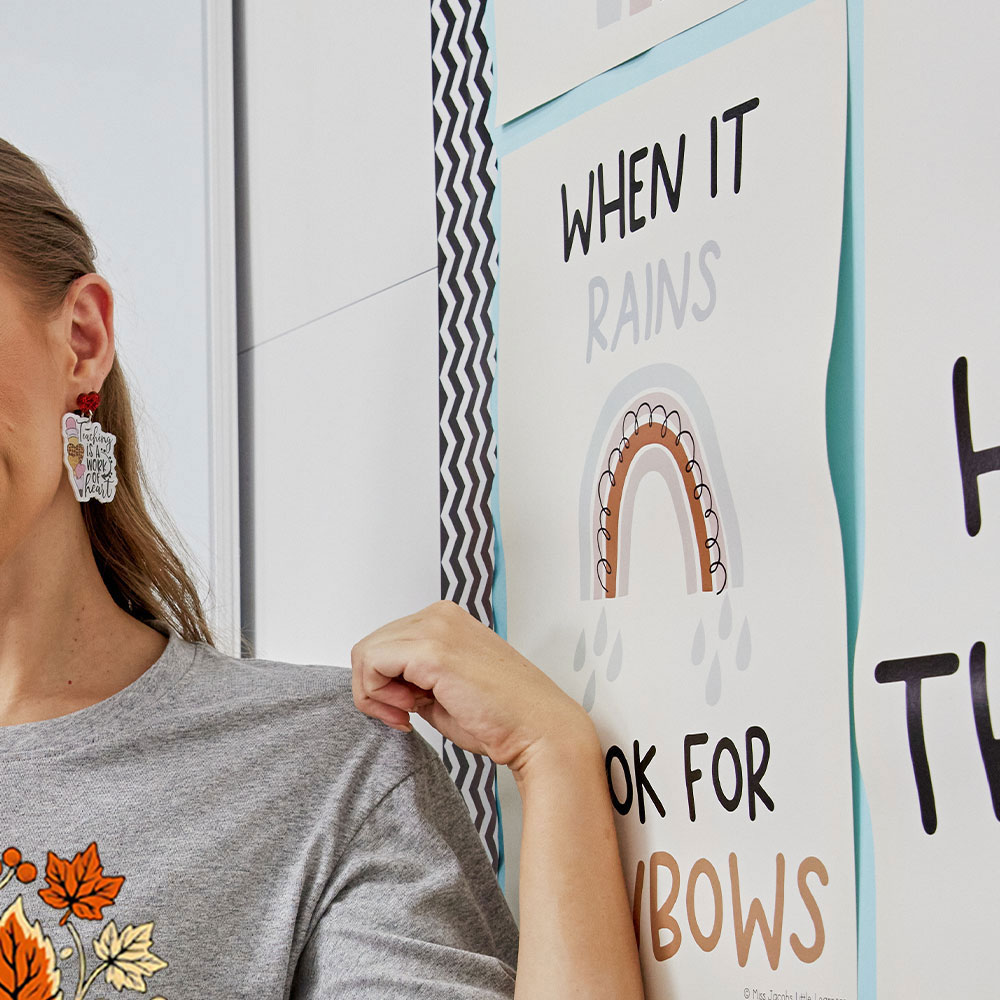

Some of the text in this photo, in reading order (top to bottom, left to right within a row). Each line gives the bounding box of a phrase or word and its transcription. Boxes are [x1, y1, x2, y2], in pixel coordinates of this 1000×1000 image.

[561, 97, 760, 262] WHEN IT
[586, 240, 721, 364] RAINS
[76, 418, 114, 454] Teaching
[86, 443, 101, 458] IS A
[86, 459, 106, 472] WORK
[92, 473, 100, 484] OF
[84, 473, 115, 499] heart
[684, 726, 775, 822] FOR
[752, 989, 766, 1000] Miss
